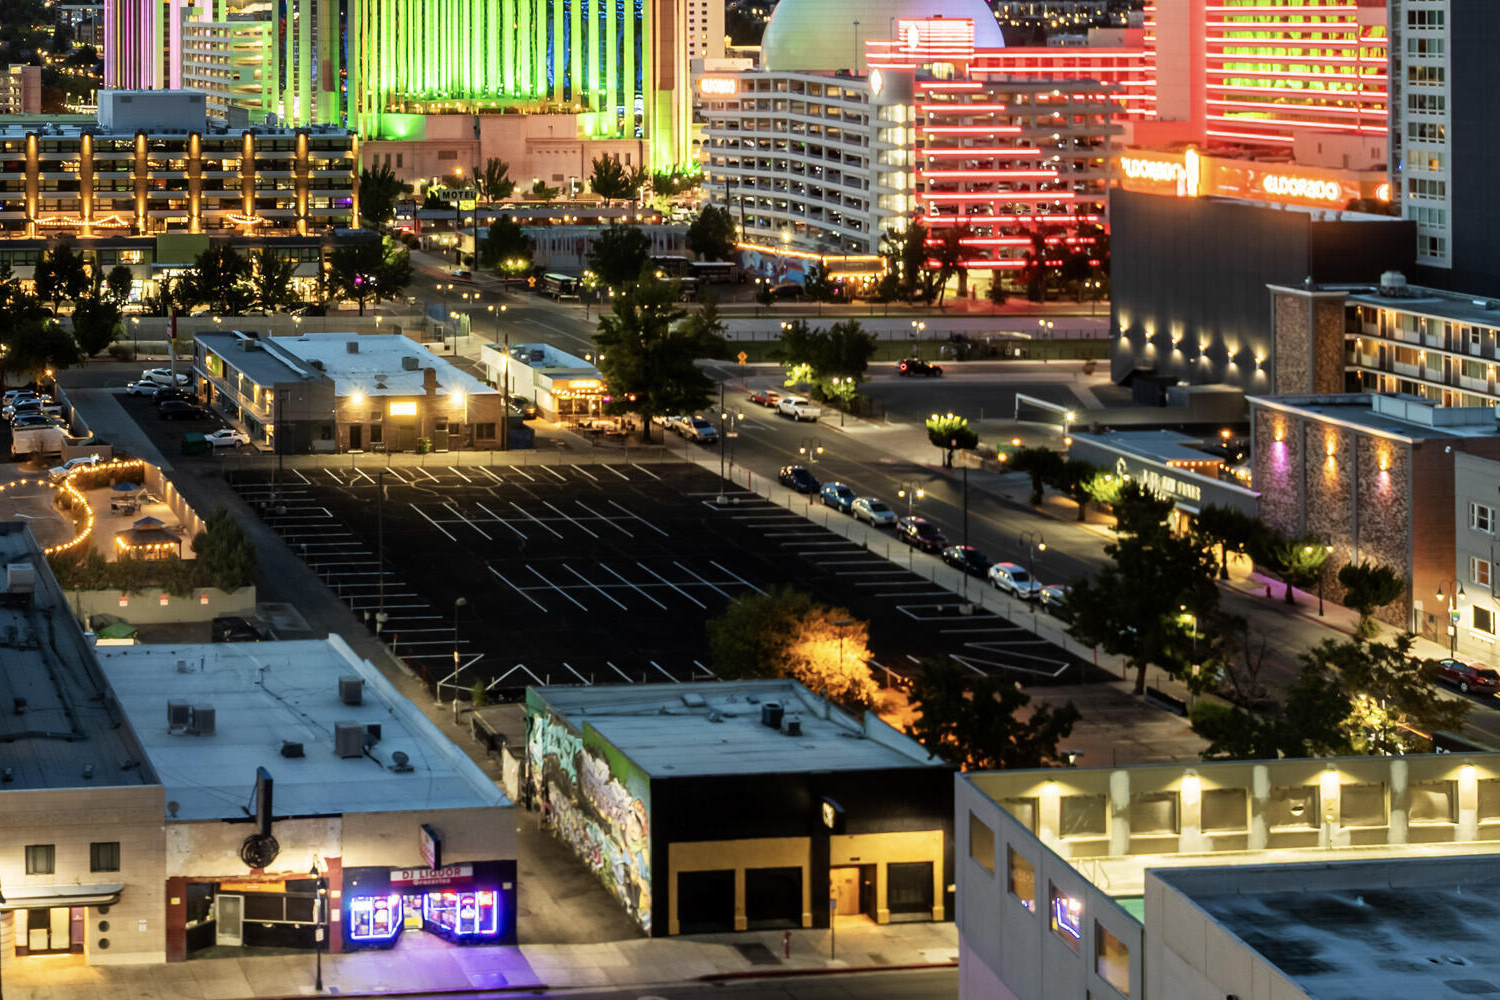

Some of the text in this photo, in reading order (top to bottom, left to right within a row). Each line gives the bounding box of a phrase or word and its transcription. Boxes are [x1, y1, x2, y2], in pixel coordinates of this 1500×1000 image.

[442, 191, 477, 199] MOTEL
[402, 867, 461, 879] DJ LIQUOR
